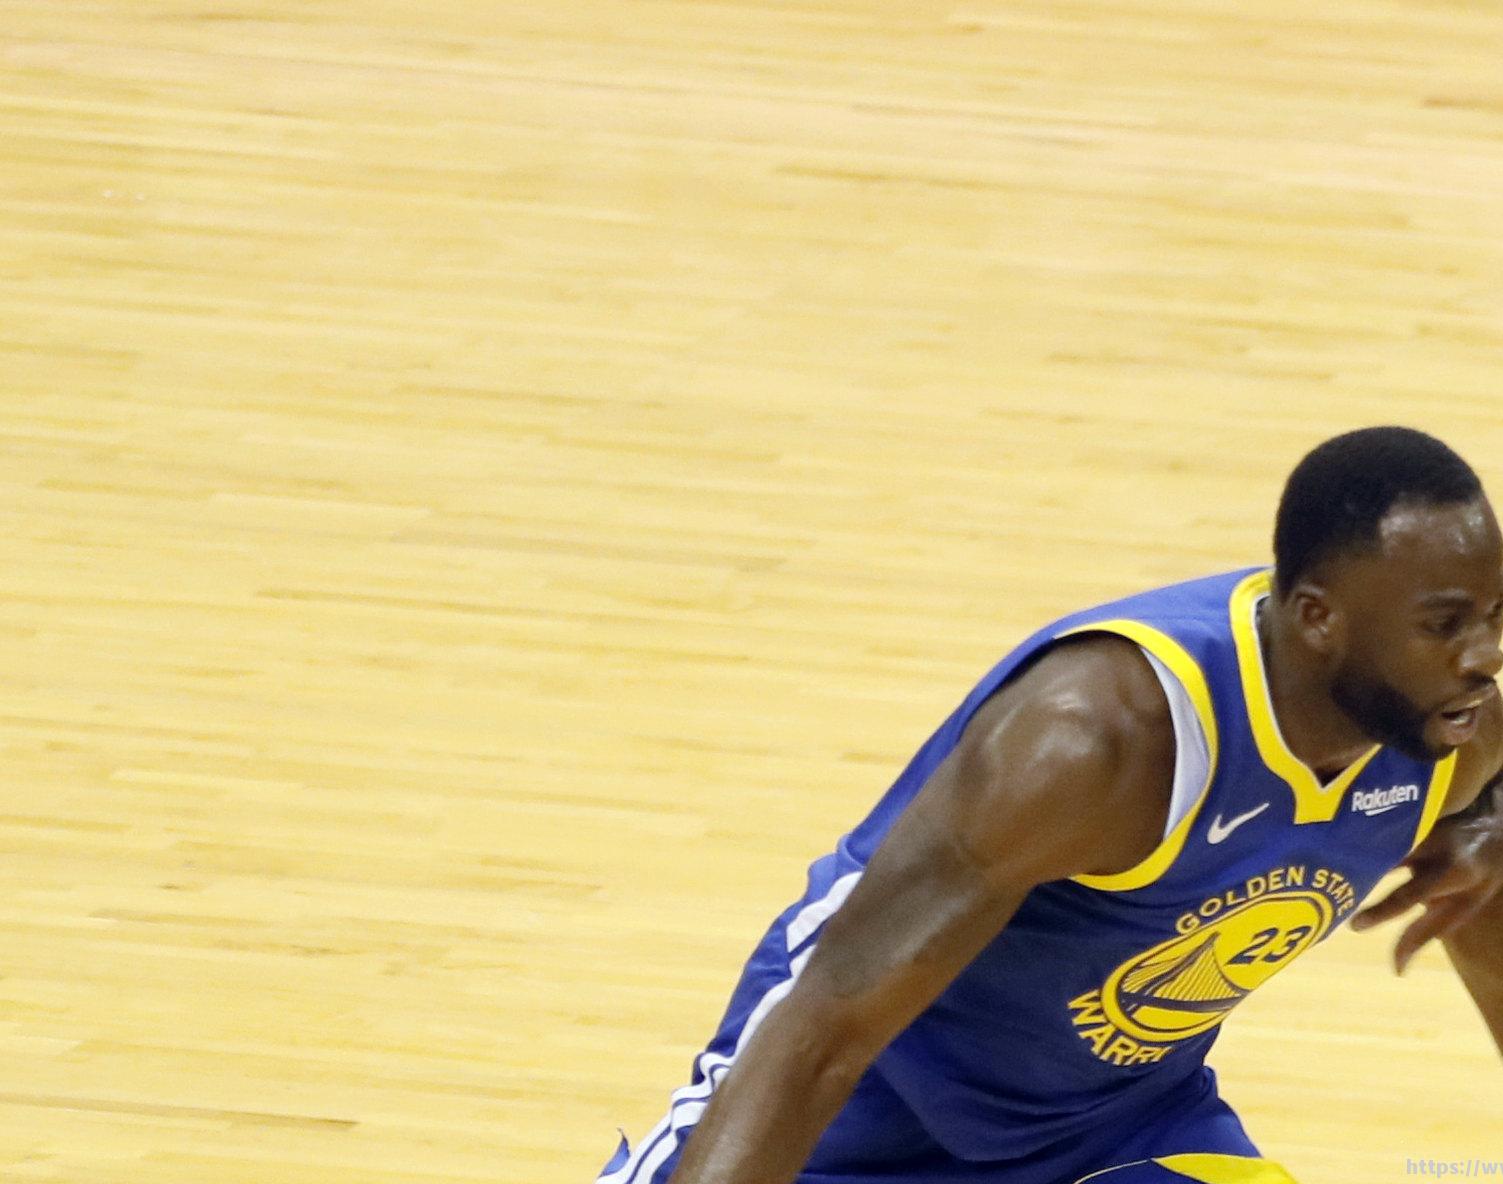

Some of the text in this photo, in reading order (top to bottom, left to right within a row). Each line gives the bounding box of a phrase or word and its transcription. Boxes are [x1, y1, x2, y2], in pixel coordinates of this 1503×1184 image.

[1351, 785, 1418, 813] Rakuten
[1175, 866, 1355, 935] GOLDEN STATE
[1226, 925, 1311, 963] 23
[1067, 988, 1172, 1066] WARRI
